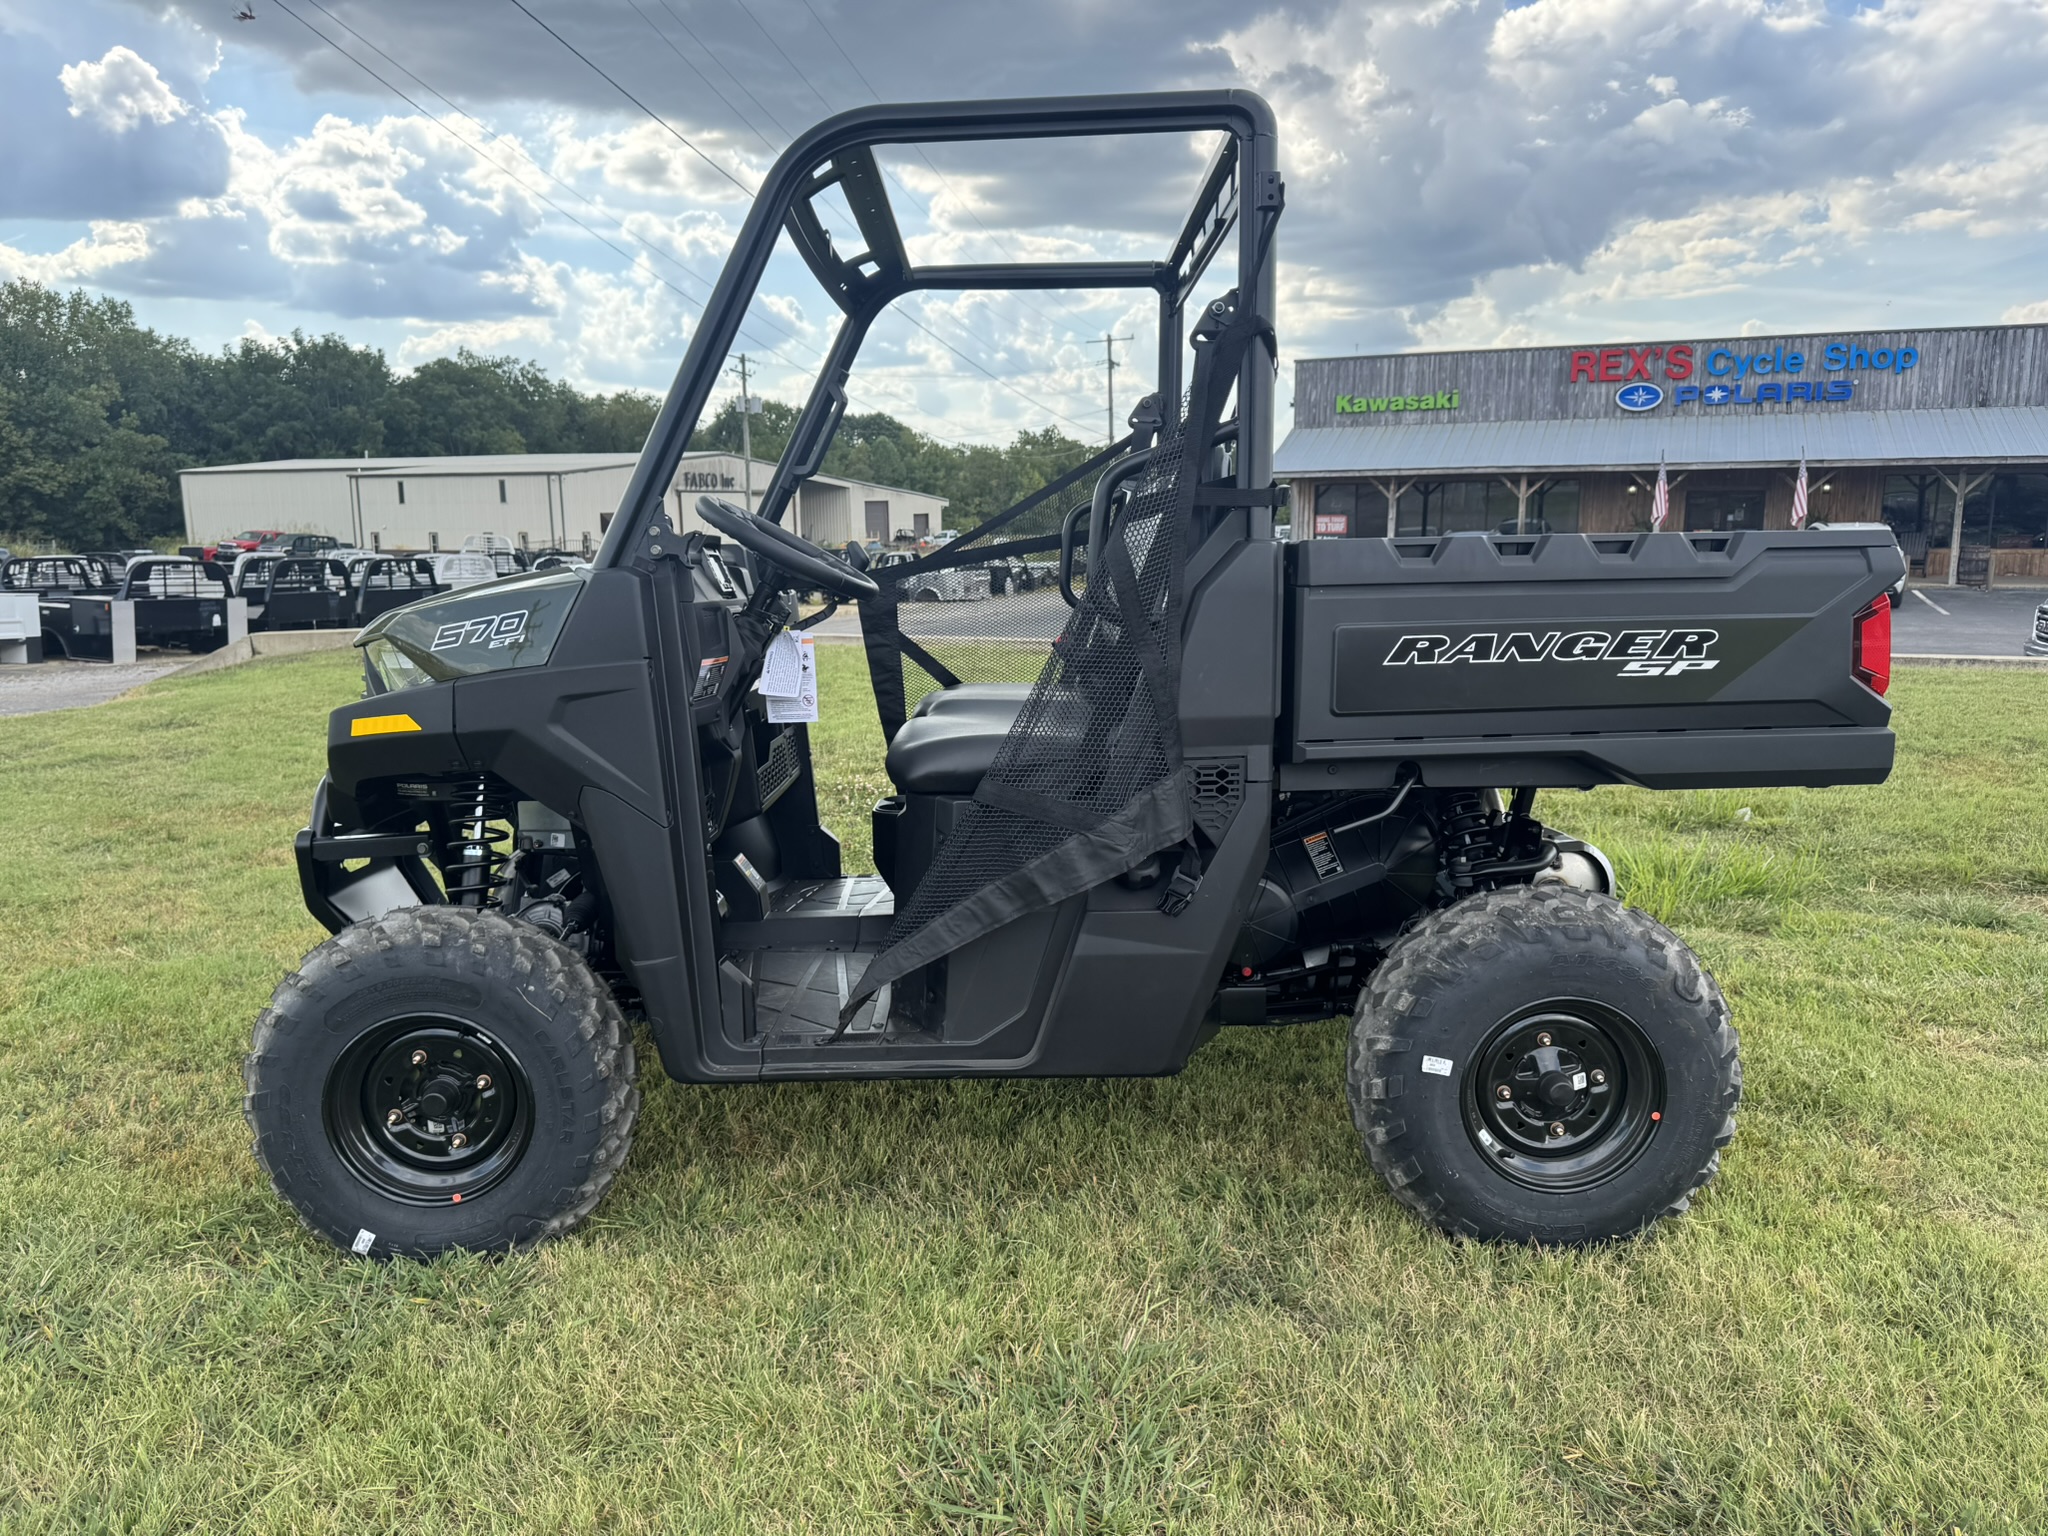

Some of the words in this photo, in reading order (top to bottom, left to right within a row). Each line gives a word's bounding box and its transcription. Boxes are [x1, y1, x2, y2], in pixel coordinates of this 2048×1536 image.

[1570, 345, 1694, 383] REX'S
[1706, 347, 1805, 381] Cycle
[1823, 342, 1919, 375] Shop
[1336, 389, 1459, 414] Kawasaki
[1673, 380, 1853, 407] POLARIS
[684, 472, 718, 488] FABCO
[1317, 523, 1326, 531] TO
[1328, 523, 1344, 531] TURF
[430, 609, 528, 651] 570
[488, 634, 526, 649] EFI
[1382, 629, 1719, 665] RANGER
[1616, 660, 1720, 676] SP
